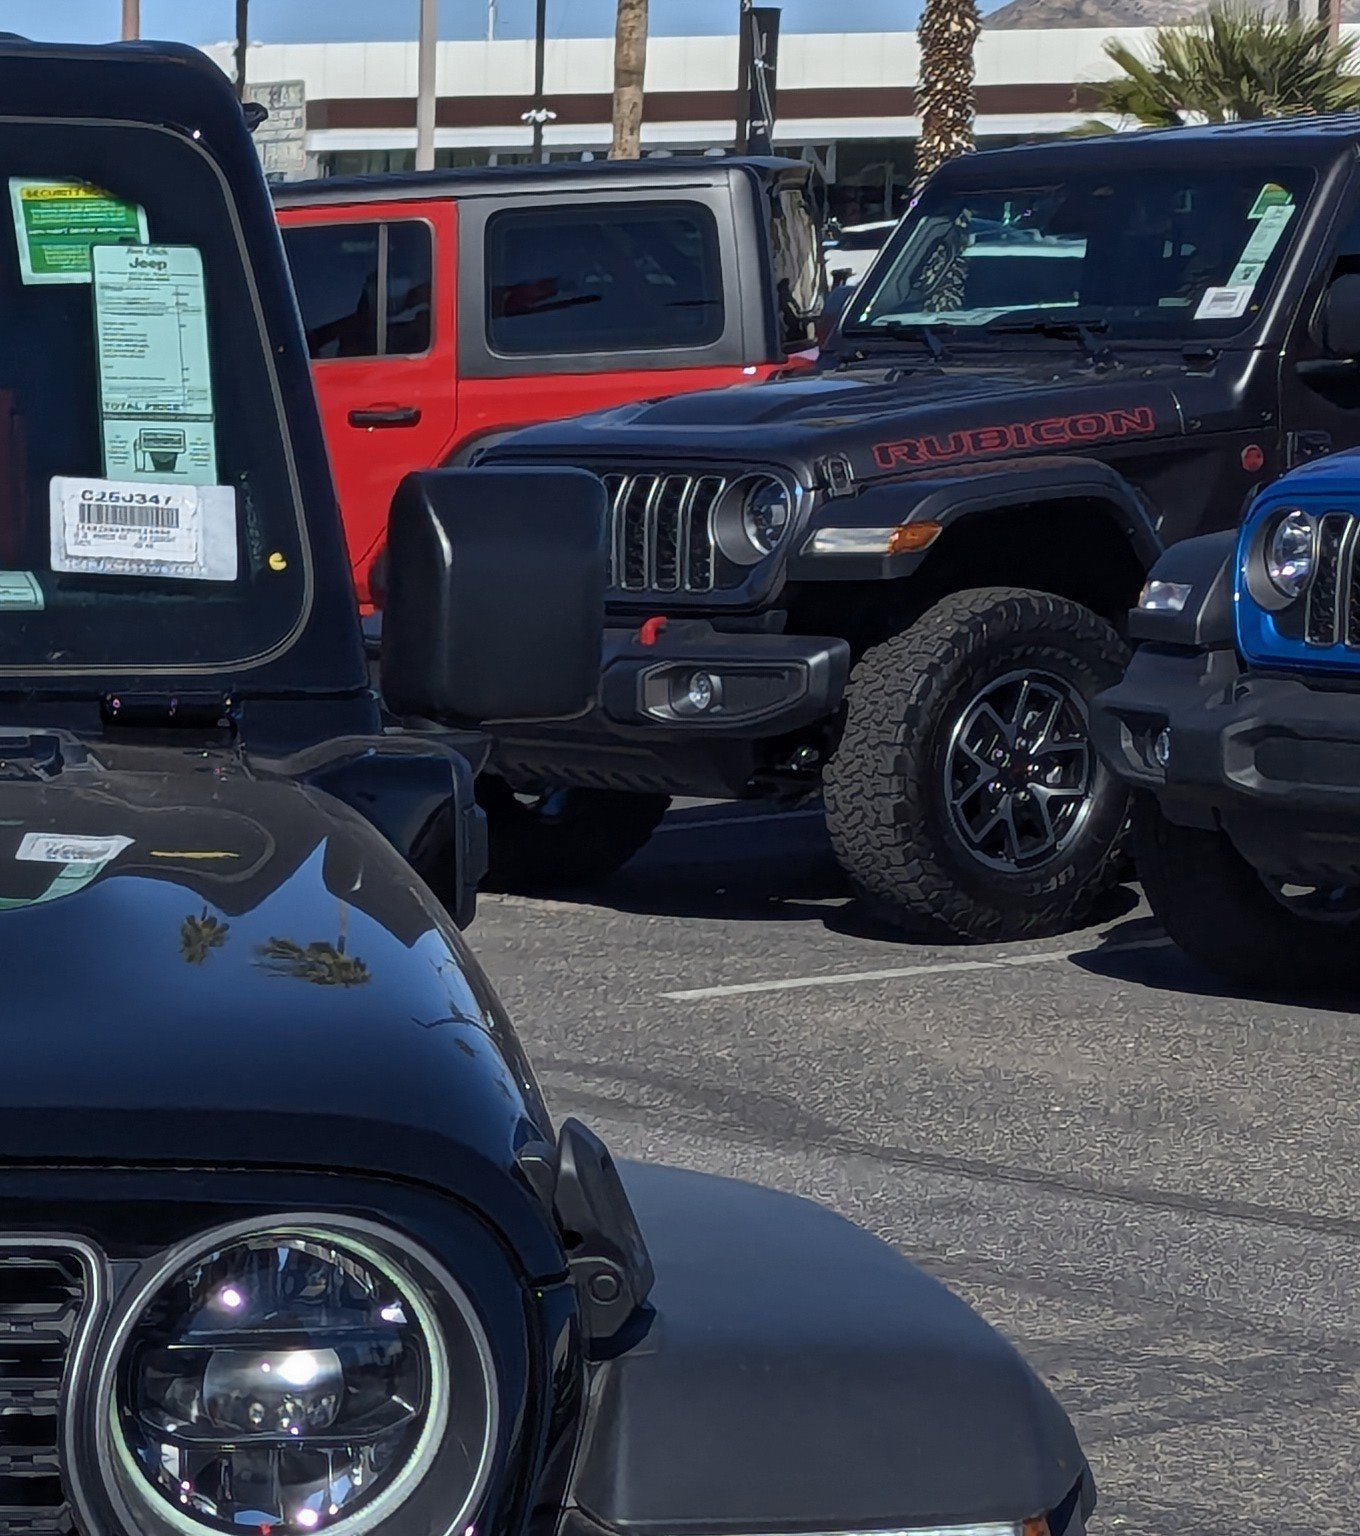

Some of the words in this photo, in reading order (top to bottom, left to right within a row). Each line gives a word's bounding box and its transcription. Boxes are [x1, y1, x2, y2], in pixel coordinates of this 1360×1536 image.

[128, 257, 168, 271] Jeep
[104, 401, 142, 411] TOTAL
[873, 407, 1156, 469] RUBICON
